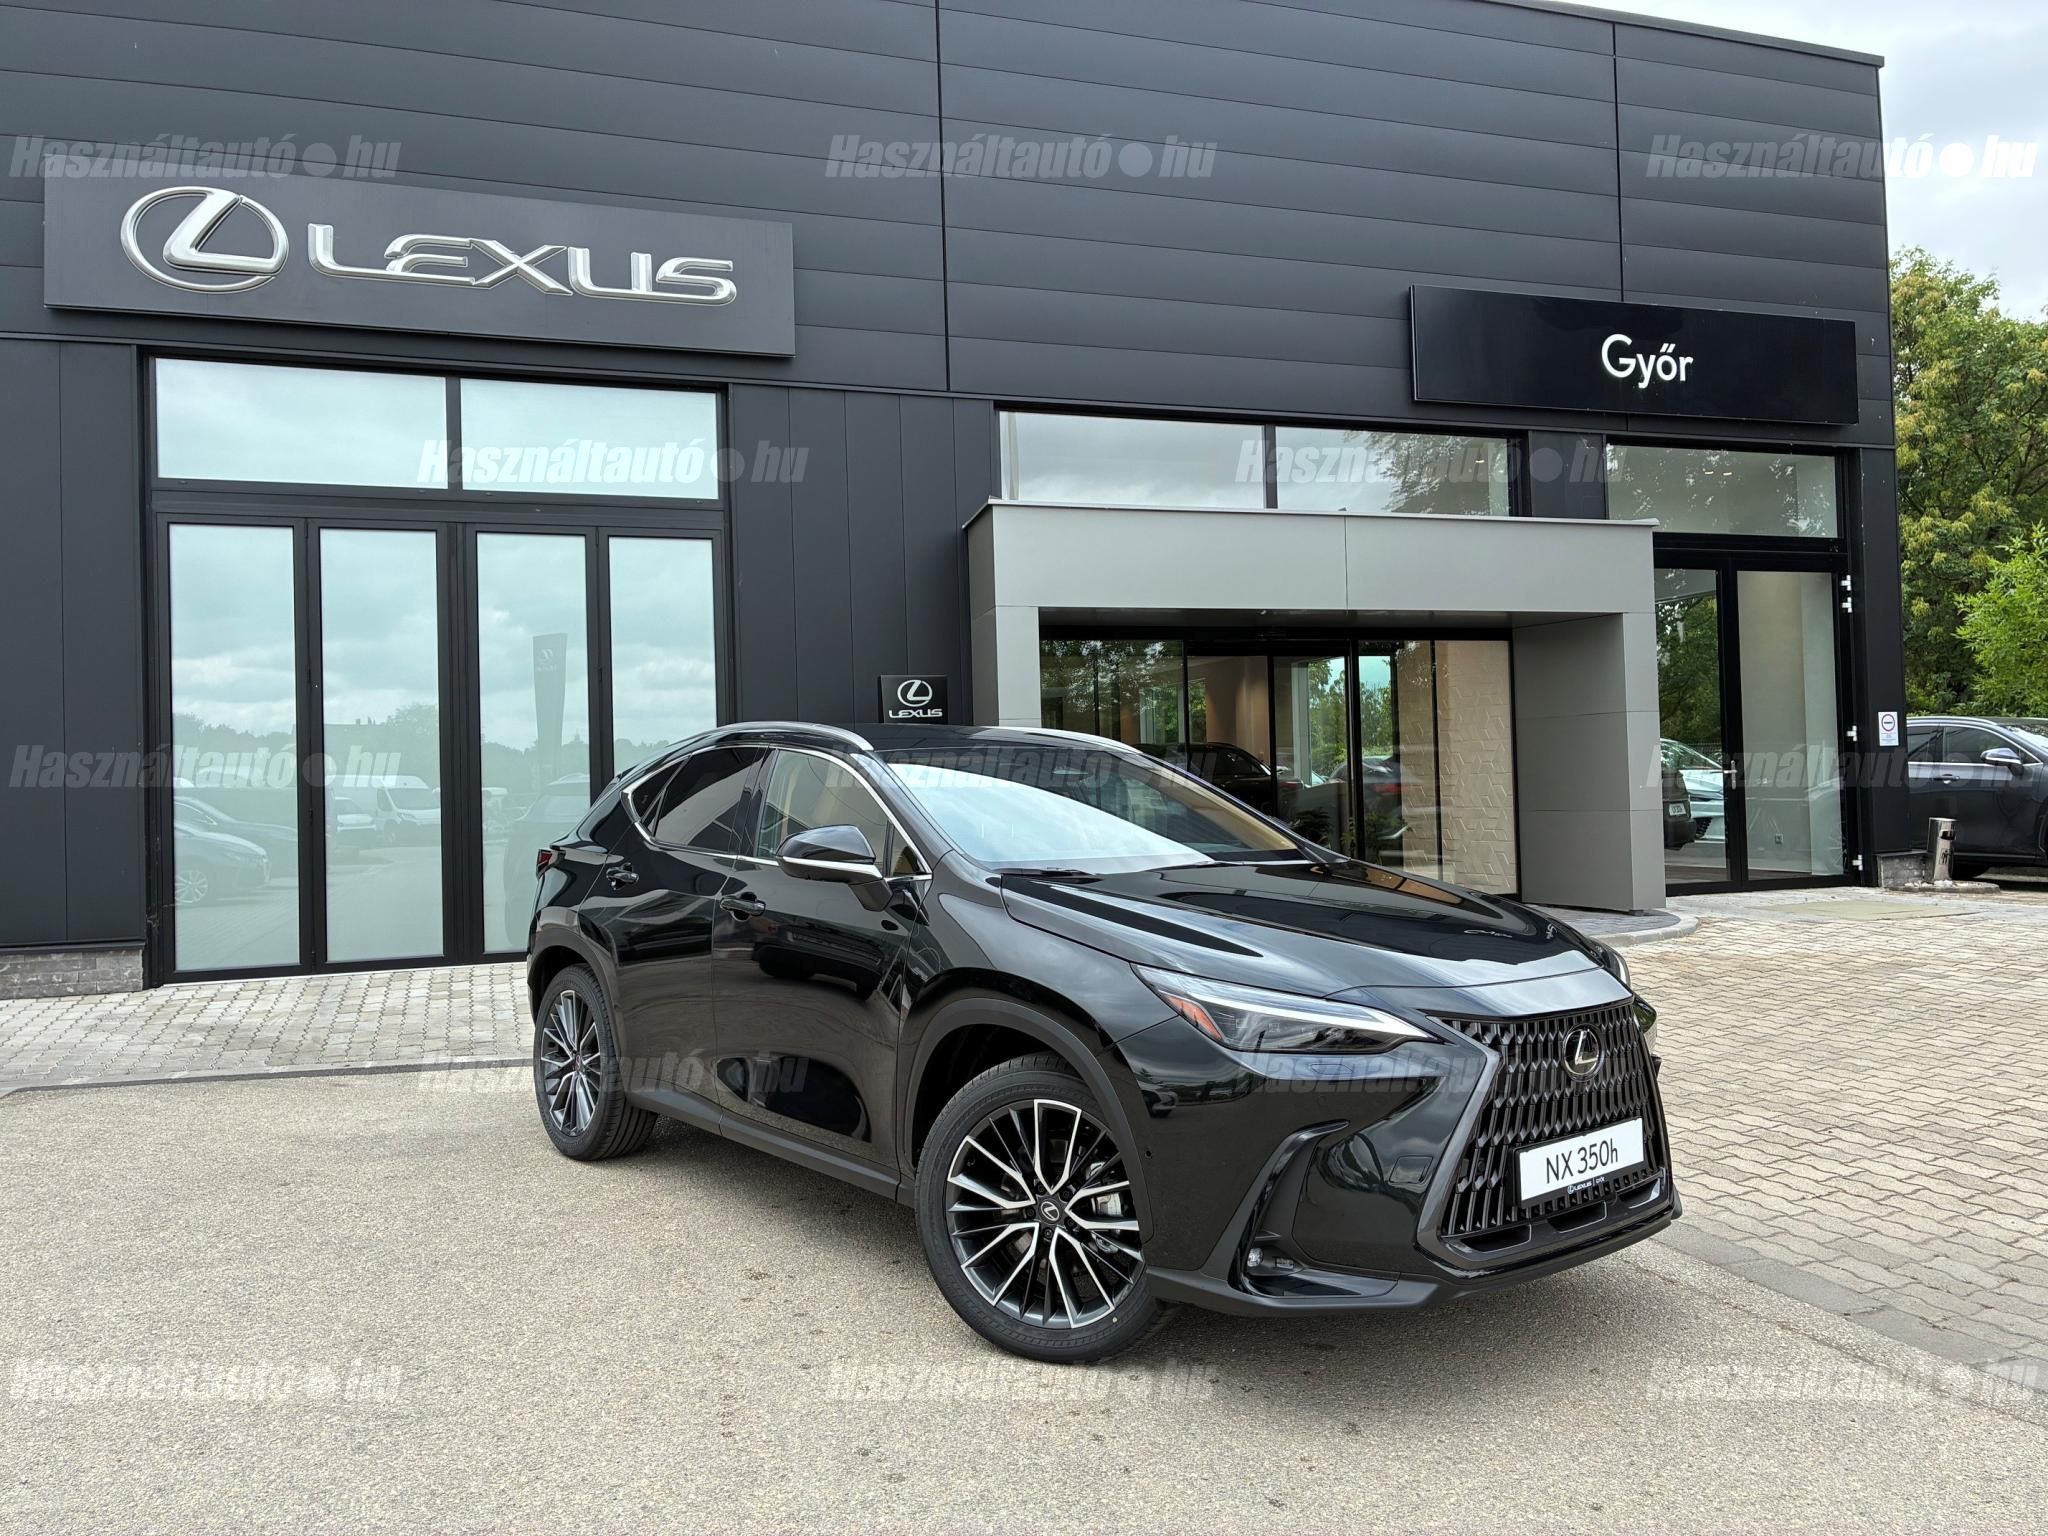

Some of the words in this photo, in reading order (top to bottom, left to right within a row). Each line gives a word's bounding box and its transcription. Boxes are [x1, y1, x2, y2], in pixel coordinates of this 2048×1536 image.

[307, 222, 738, 307] LEXUS
[1601, 332, 1694, 390] Győr
[888, 708, 943, 719] LEXUS
[1546, 1150, 1574, 1184] NX
[1577, 1138, 1619, 1174] 350h
